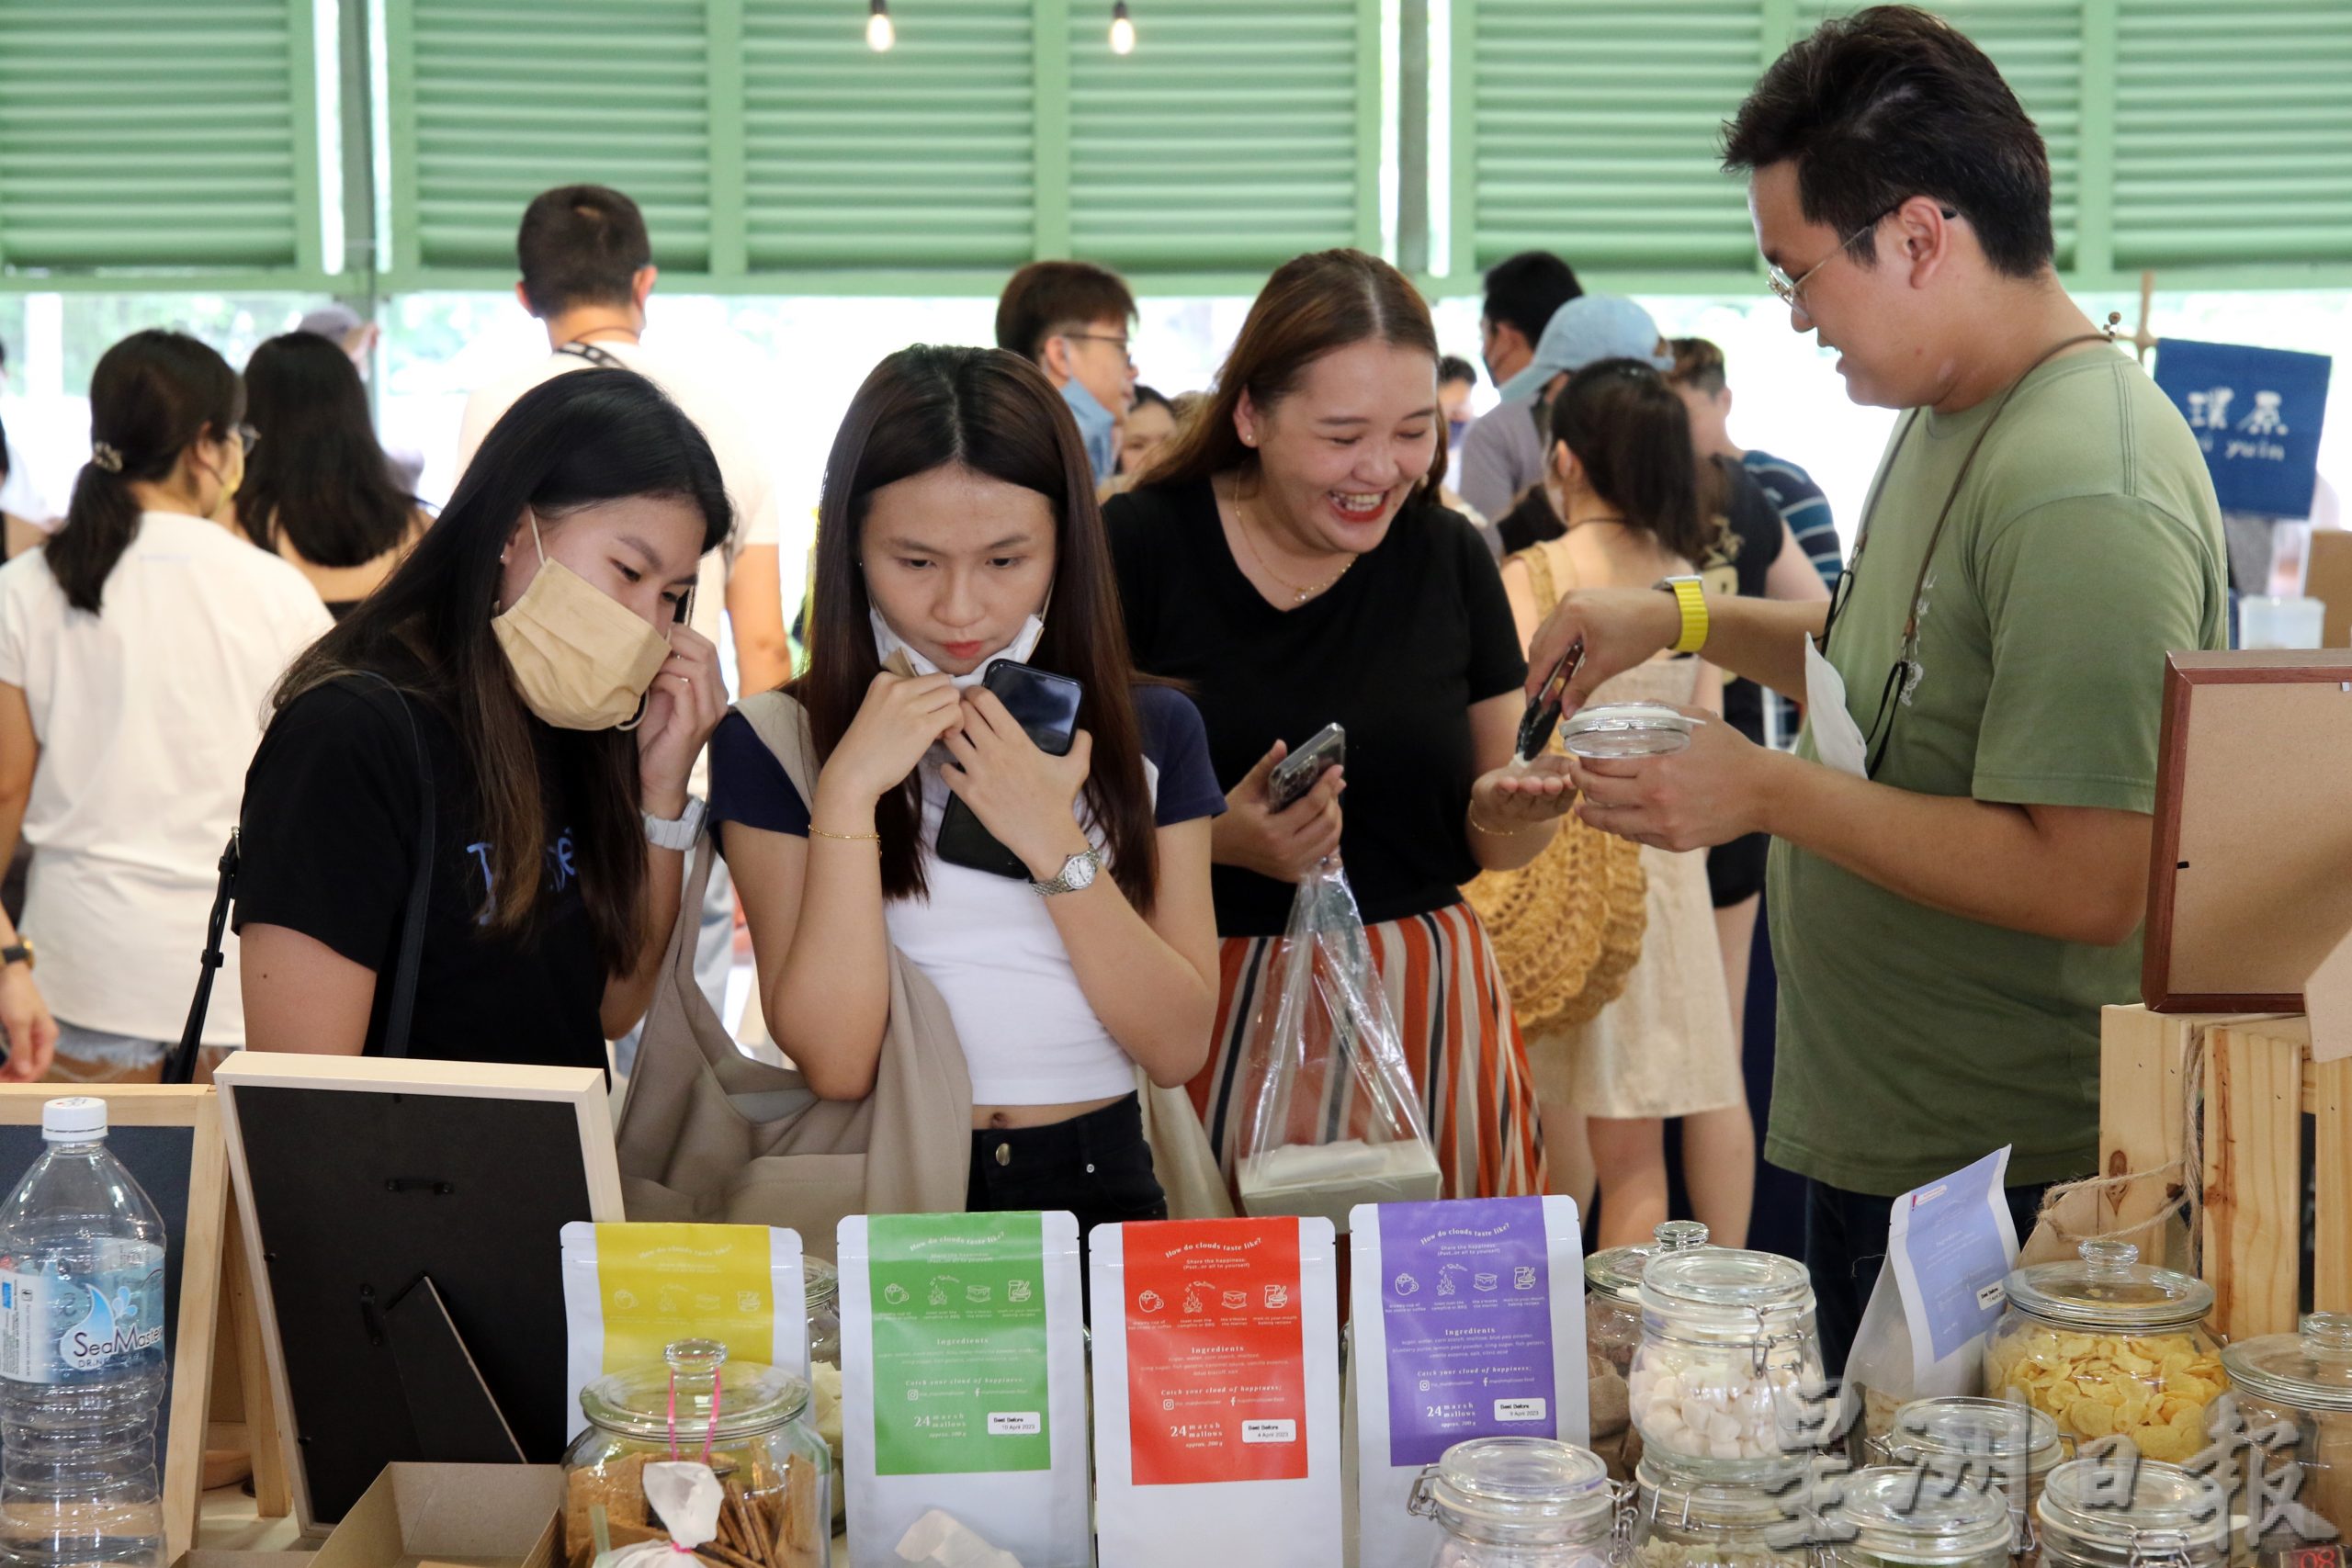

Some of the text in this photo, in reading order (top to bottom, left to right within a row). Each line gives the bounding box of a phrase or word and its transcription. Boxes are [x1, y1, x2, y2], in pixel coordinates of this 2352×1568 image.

[1420, 1235, 1436, 1246] How
[1493, 1222, 1510, 1235] like?
[1165, 1248, 1182, 1258] How
[1244, 1237, 1261, 1249] like?
[1445, 1327, 1496, 1336] Ingredients
[74, 1325, 163, 1357] SeaMaster
[937, 1337, 989, 1346] Ingredients
[1192, 1346, 1244, 1354] Ingredients
[1427, 1405, 1442, 1417] 24
[914, 1416, 930, 1427] 24
[1170, 1425, 1186, 1437] 24
